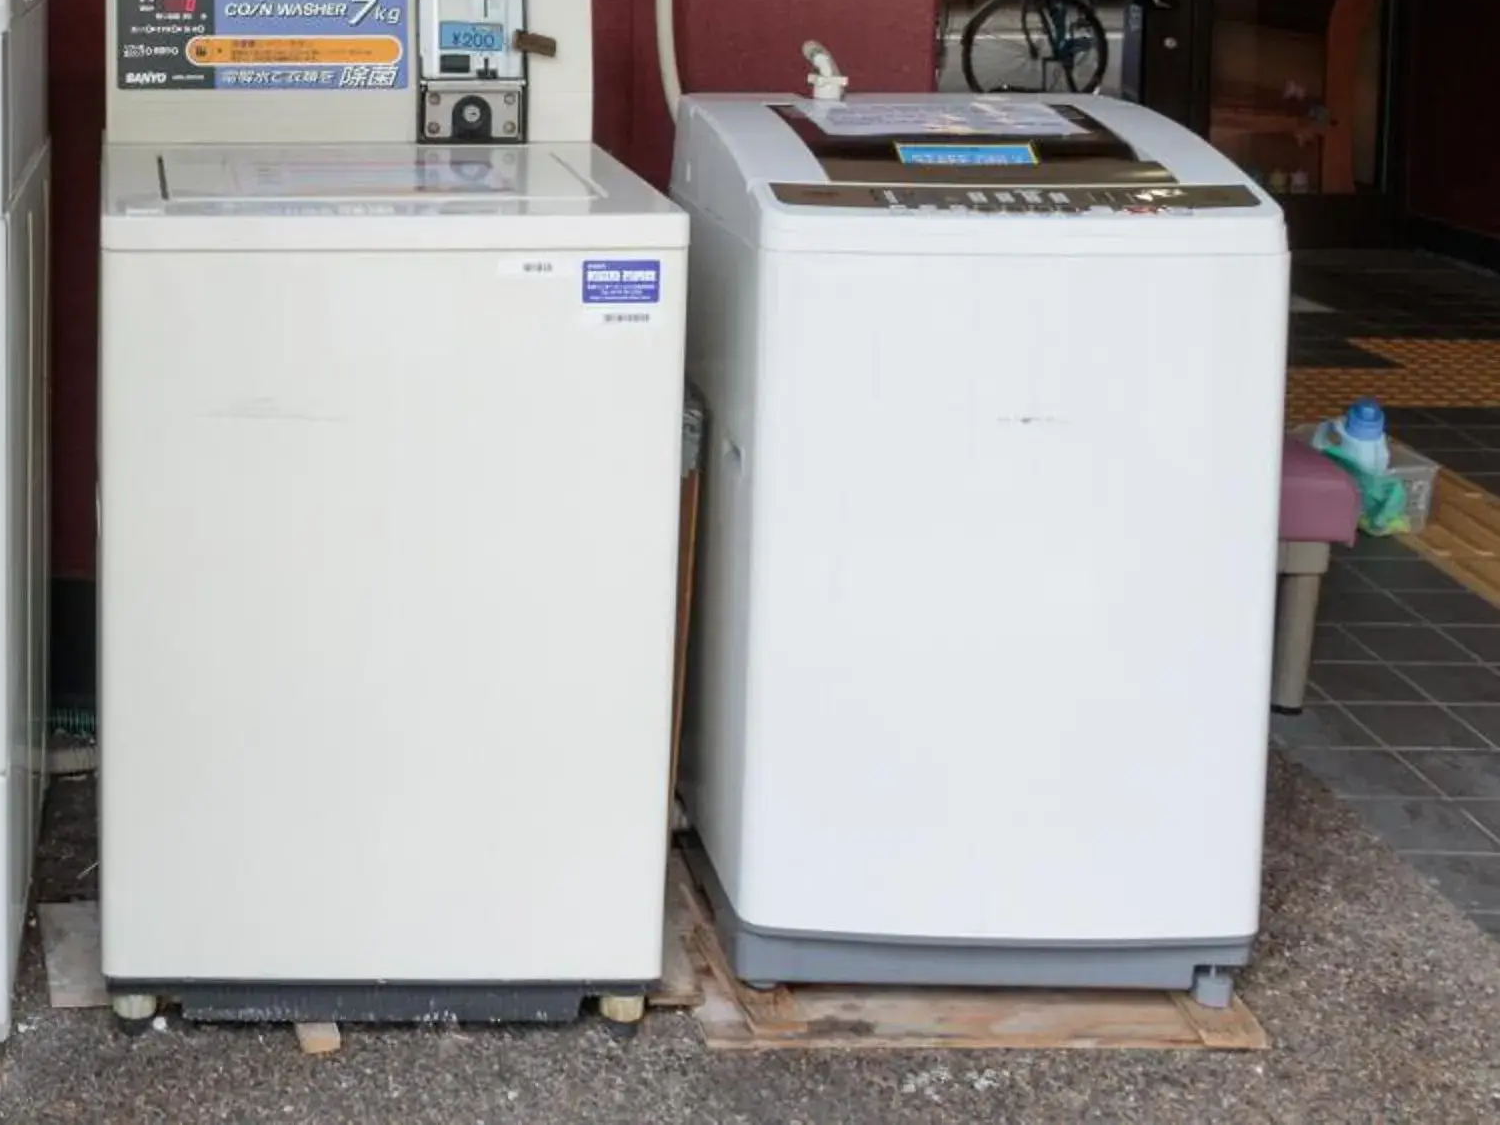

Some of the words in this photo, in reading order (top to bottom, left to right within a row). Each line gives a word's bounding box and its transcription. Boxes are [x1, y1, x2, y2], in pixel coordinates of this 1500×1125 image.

[224, 0, 273, 17] COIN
[276, 1, 348, 17] WASHER
[452, 31, 495, 48] ¥200
[125, 72, 167, 84] SANYO
